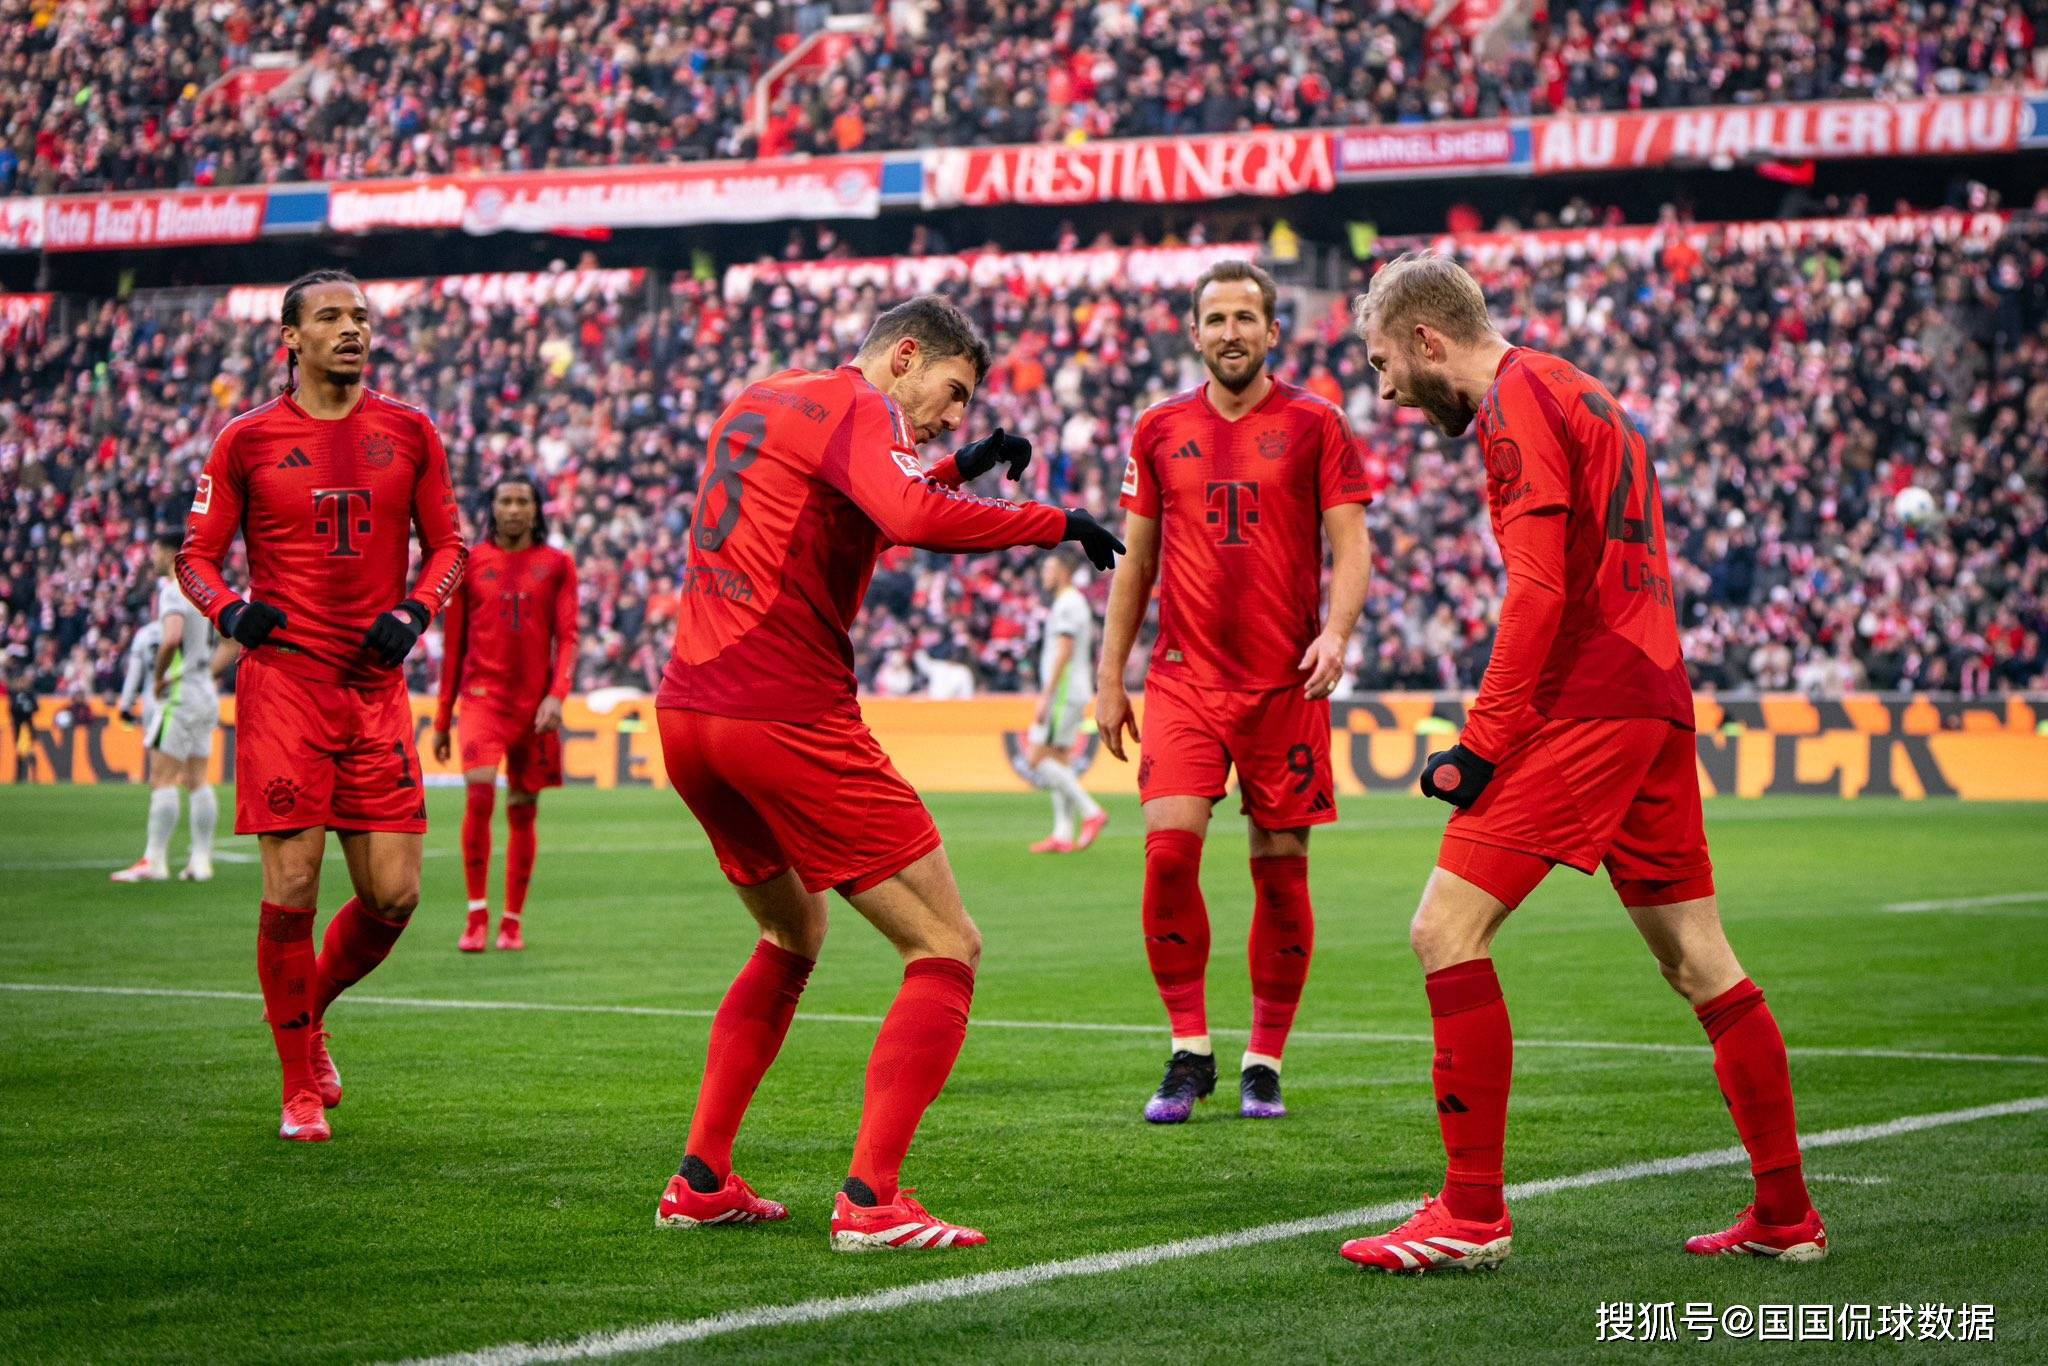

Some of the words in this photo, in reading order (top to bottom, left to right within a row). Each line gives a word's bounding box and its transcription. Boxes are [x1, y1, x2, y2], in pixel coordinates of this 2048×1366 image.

[1541, 114, 1617, 167] AU
[1673, 99, 2015, 157] HALLERTAU
[960, 147, 1009, 204] LA
[1014, 141, 1166, 203] BESTIA
[1173, 133, 1335, 200] NEGRA
[693, 411, 766, 552] 8
[1206, 481, 1260, 547] T
[311, 488, 372, 559] T
[1287, 743, 1315, 794] 9
